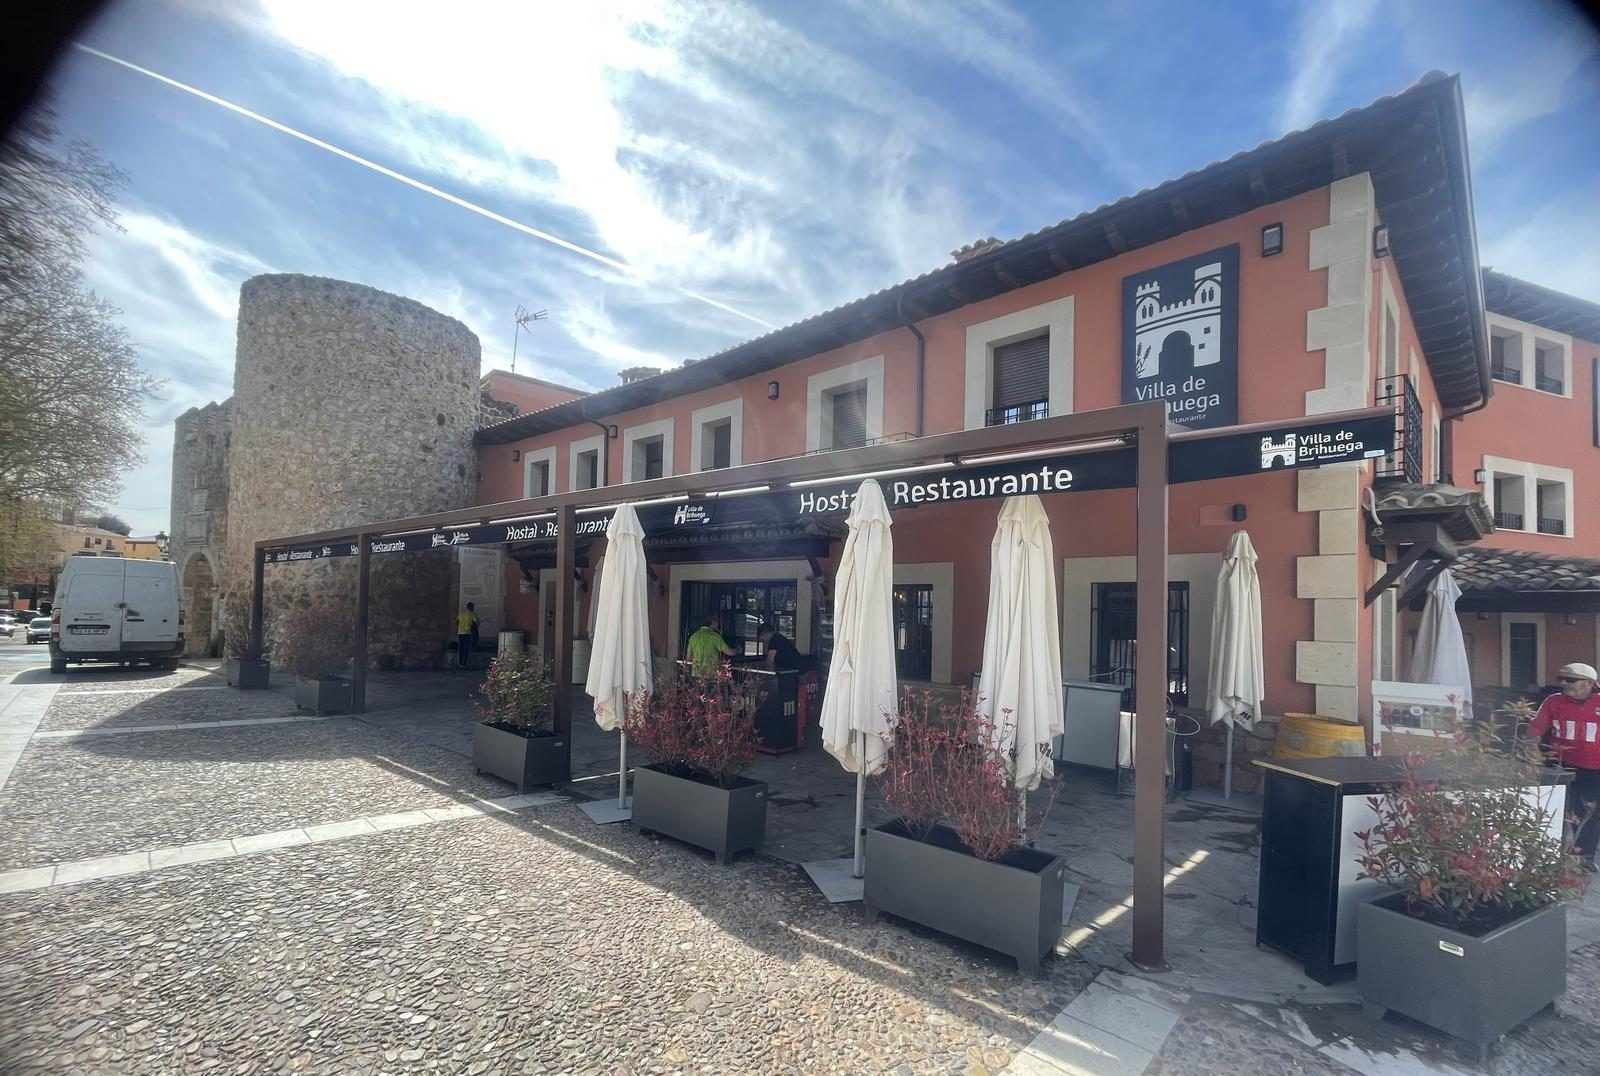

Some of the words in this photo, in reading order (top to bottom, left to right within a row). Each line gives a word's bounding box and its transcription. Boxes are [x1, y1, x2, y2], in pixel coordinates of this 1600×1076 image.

[1135, 381, 1176, 401] Villa
[1182, 375, 1206, 393] de
[1166, 393, 1220, 414] uega
[1300, 433, 1331, 446] Villa
[1335, 430, 1354, 441] de
[1299, 441, 1364, 457] Brihuega
[799, 489, 857, 514] Host
[893, 465, 1073, 504] Restaurante
[505, 522, 538, 541] Hostal
[545, 516, 613, 537] Reurant
[370, 540, 406, 553] Restaurante
